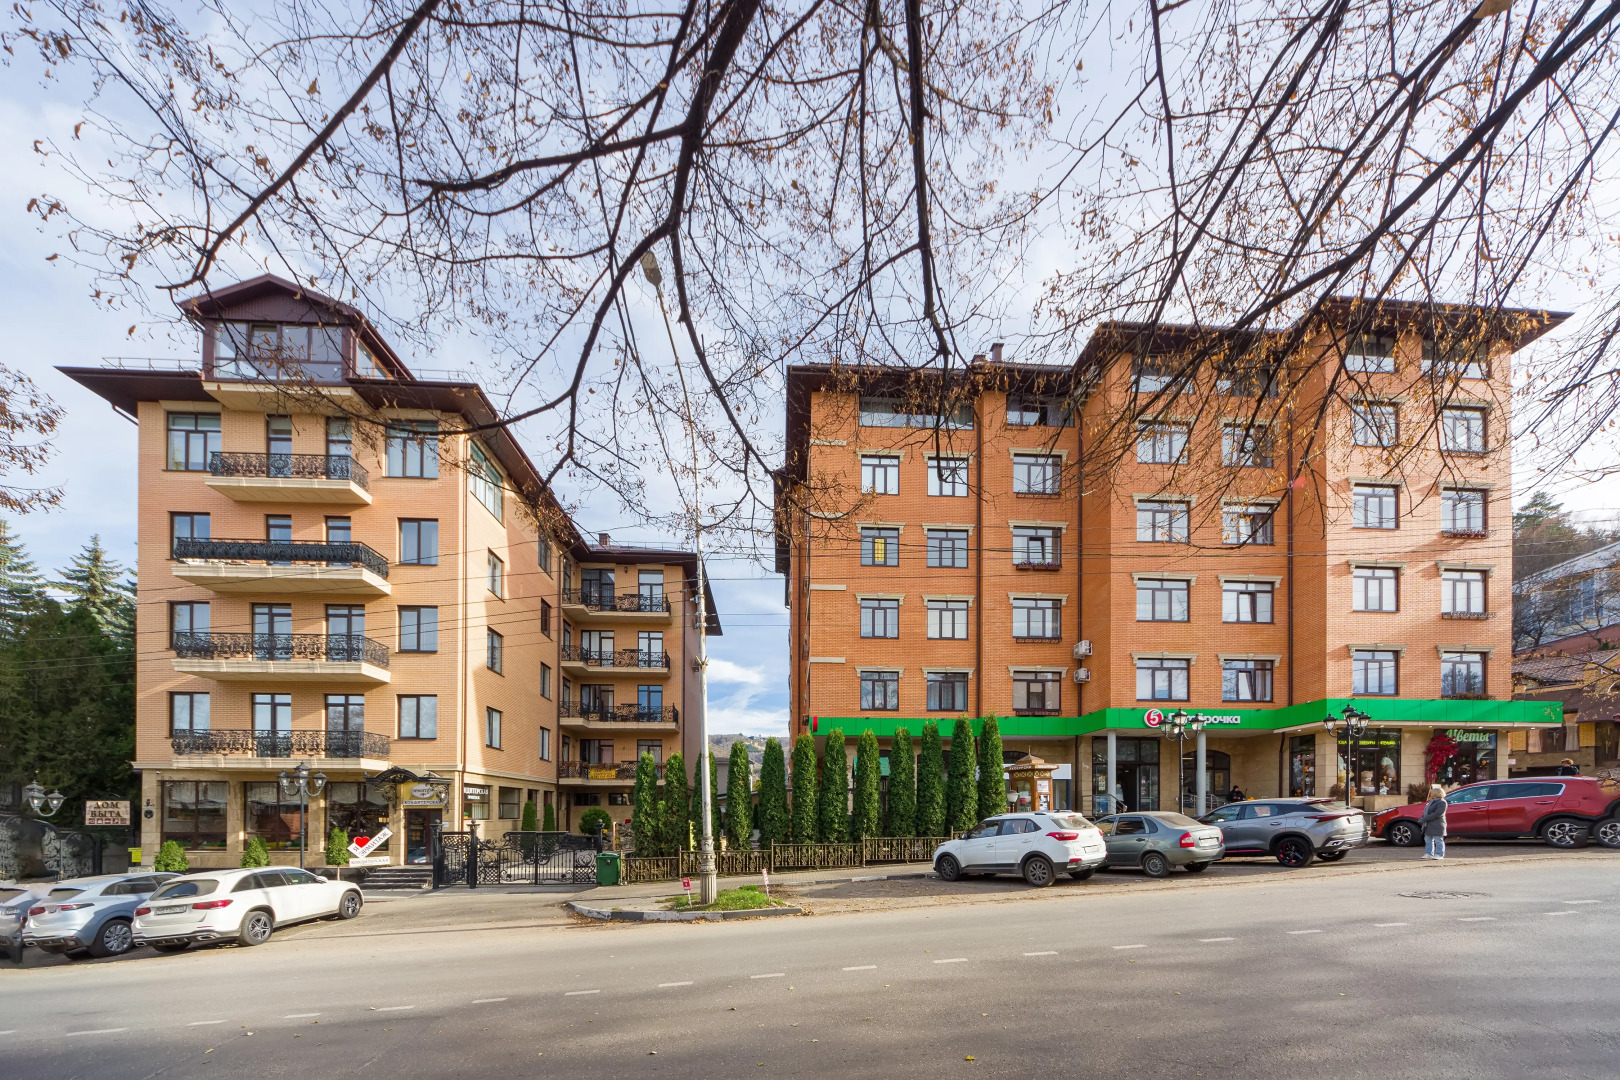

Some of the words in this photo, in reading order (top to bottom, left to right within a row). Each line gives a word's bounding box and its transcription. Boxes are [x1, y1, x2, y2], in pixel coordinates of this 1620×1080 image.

[1446, 728, 1490, 742] Цветы
[94, 801, 120, 809] ДОМ
[90, 810, 122, 818] БЫТА
